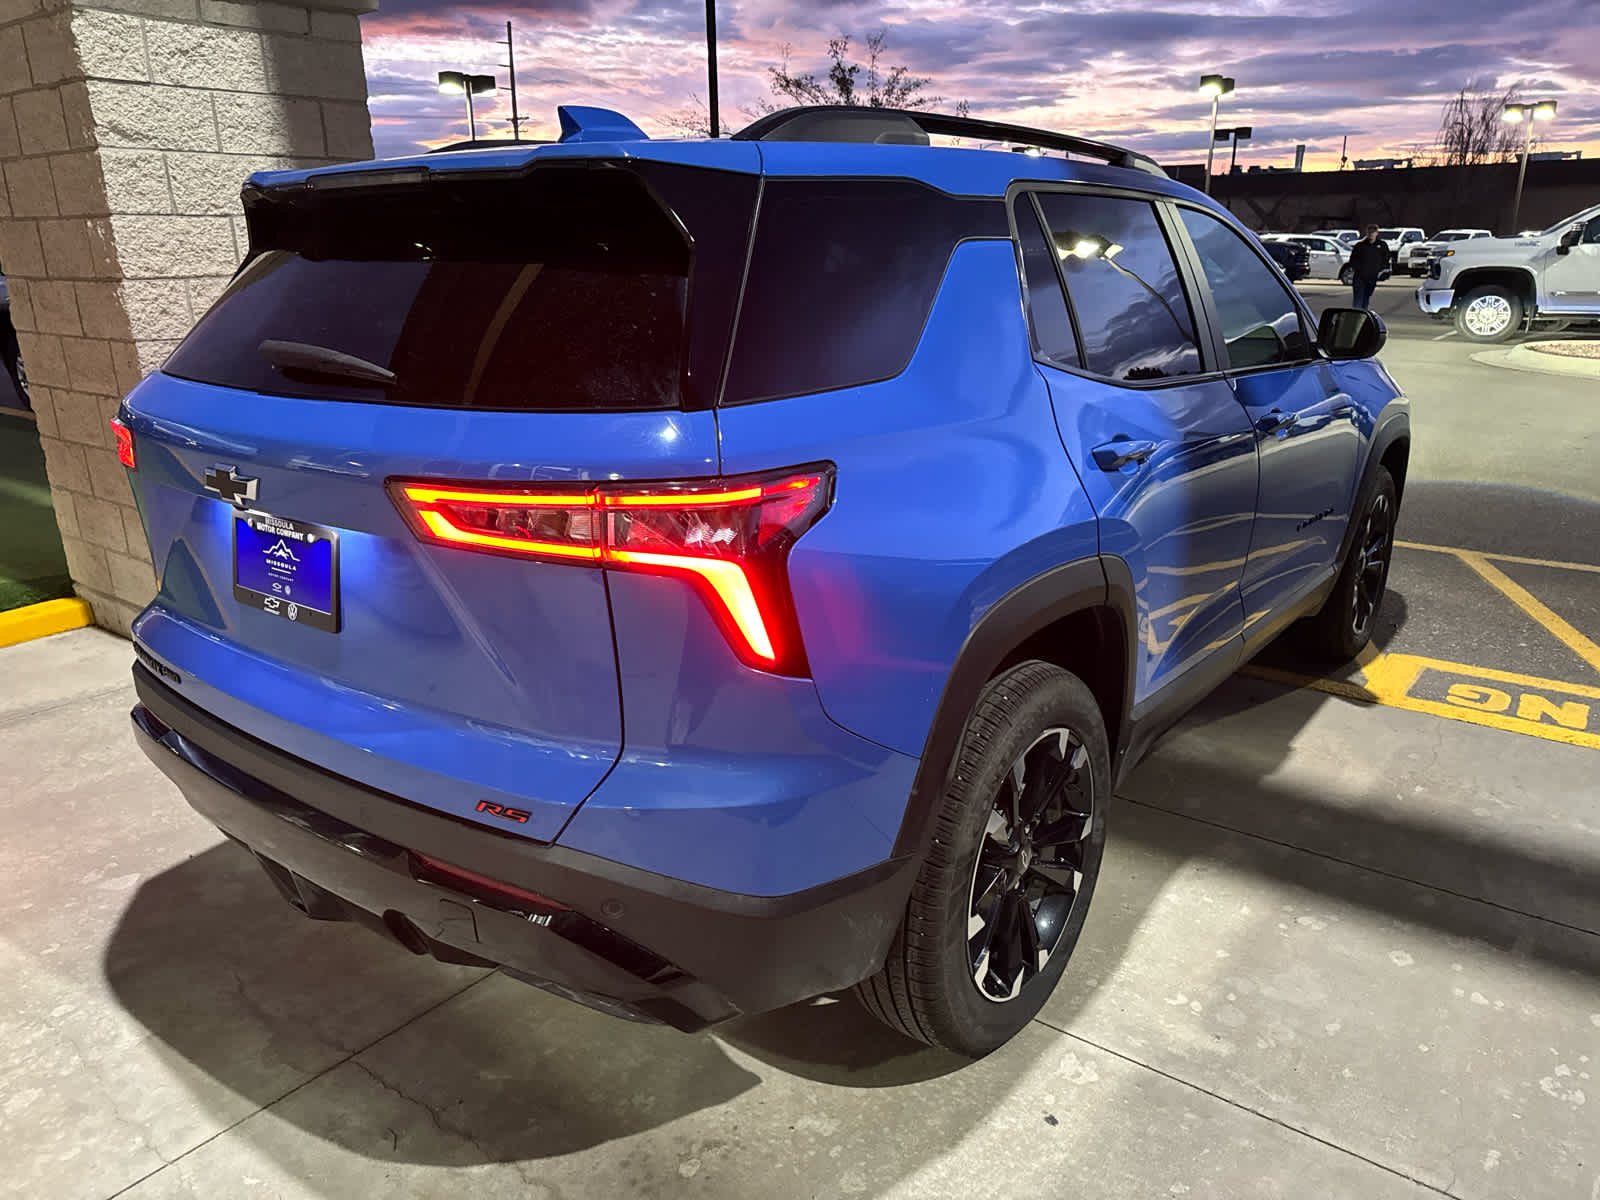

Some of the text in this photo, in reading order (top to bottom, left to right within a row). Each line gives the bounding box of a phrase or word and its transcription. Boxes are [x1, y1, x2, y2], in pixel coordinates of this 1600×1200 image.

[256, 521, 305, 542] MOTOR COMPANY
[265, 558, 297, 571] MISSOULA
[475, 799, 533, 823] RS
